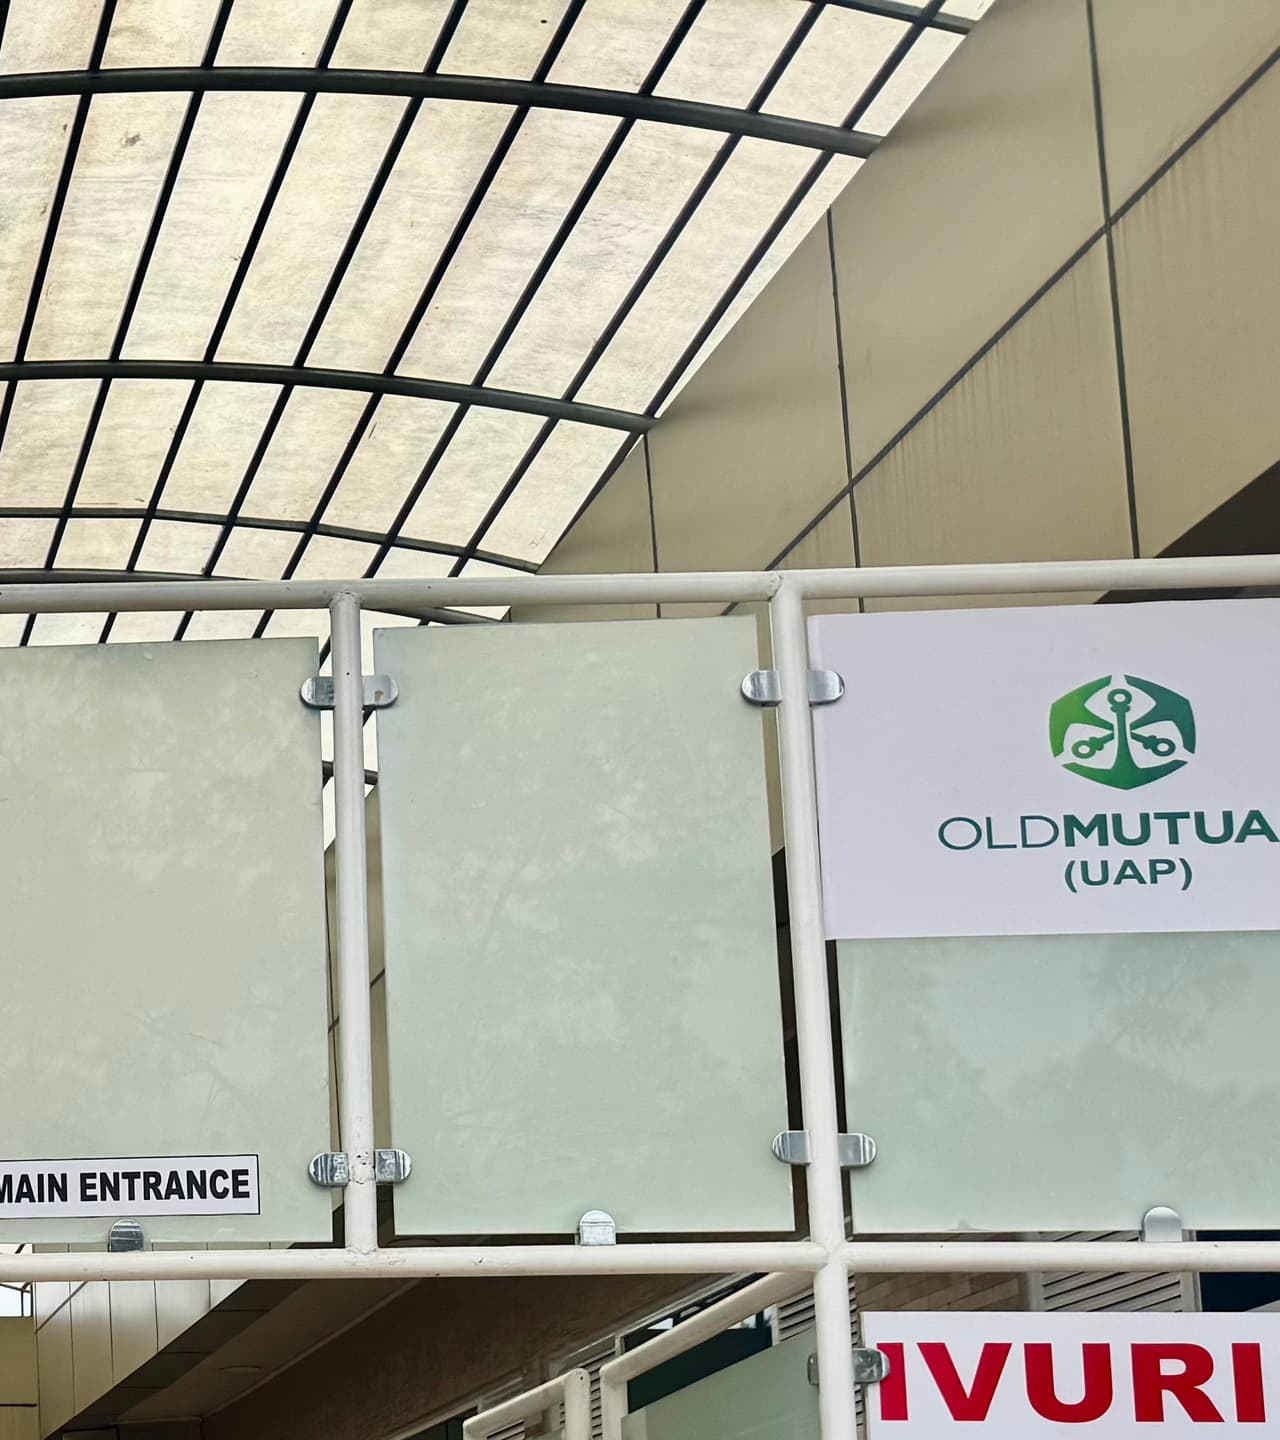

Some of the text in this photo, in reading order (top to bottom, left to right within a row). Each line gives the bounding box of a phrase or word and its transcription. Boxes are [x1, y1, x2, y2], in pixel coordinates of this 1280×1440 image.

[938, 810, 1280, 850] OLDMUTUA
[1064, 857, 1193, 893] (UAP)
[79, 1168, 251, 1202] ENTRANCE
[876, 1342, 1266, 1423] IVURI
